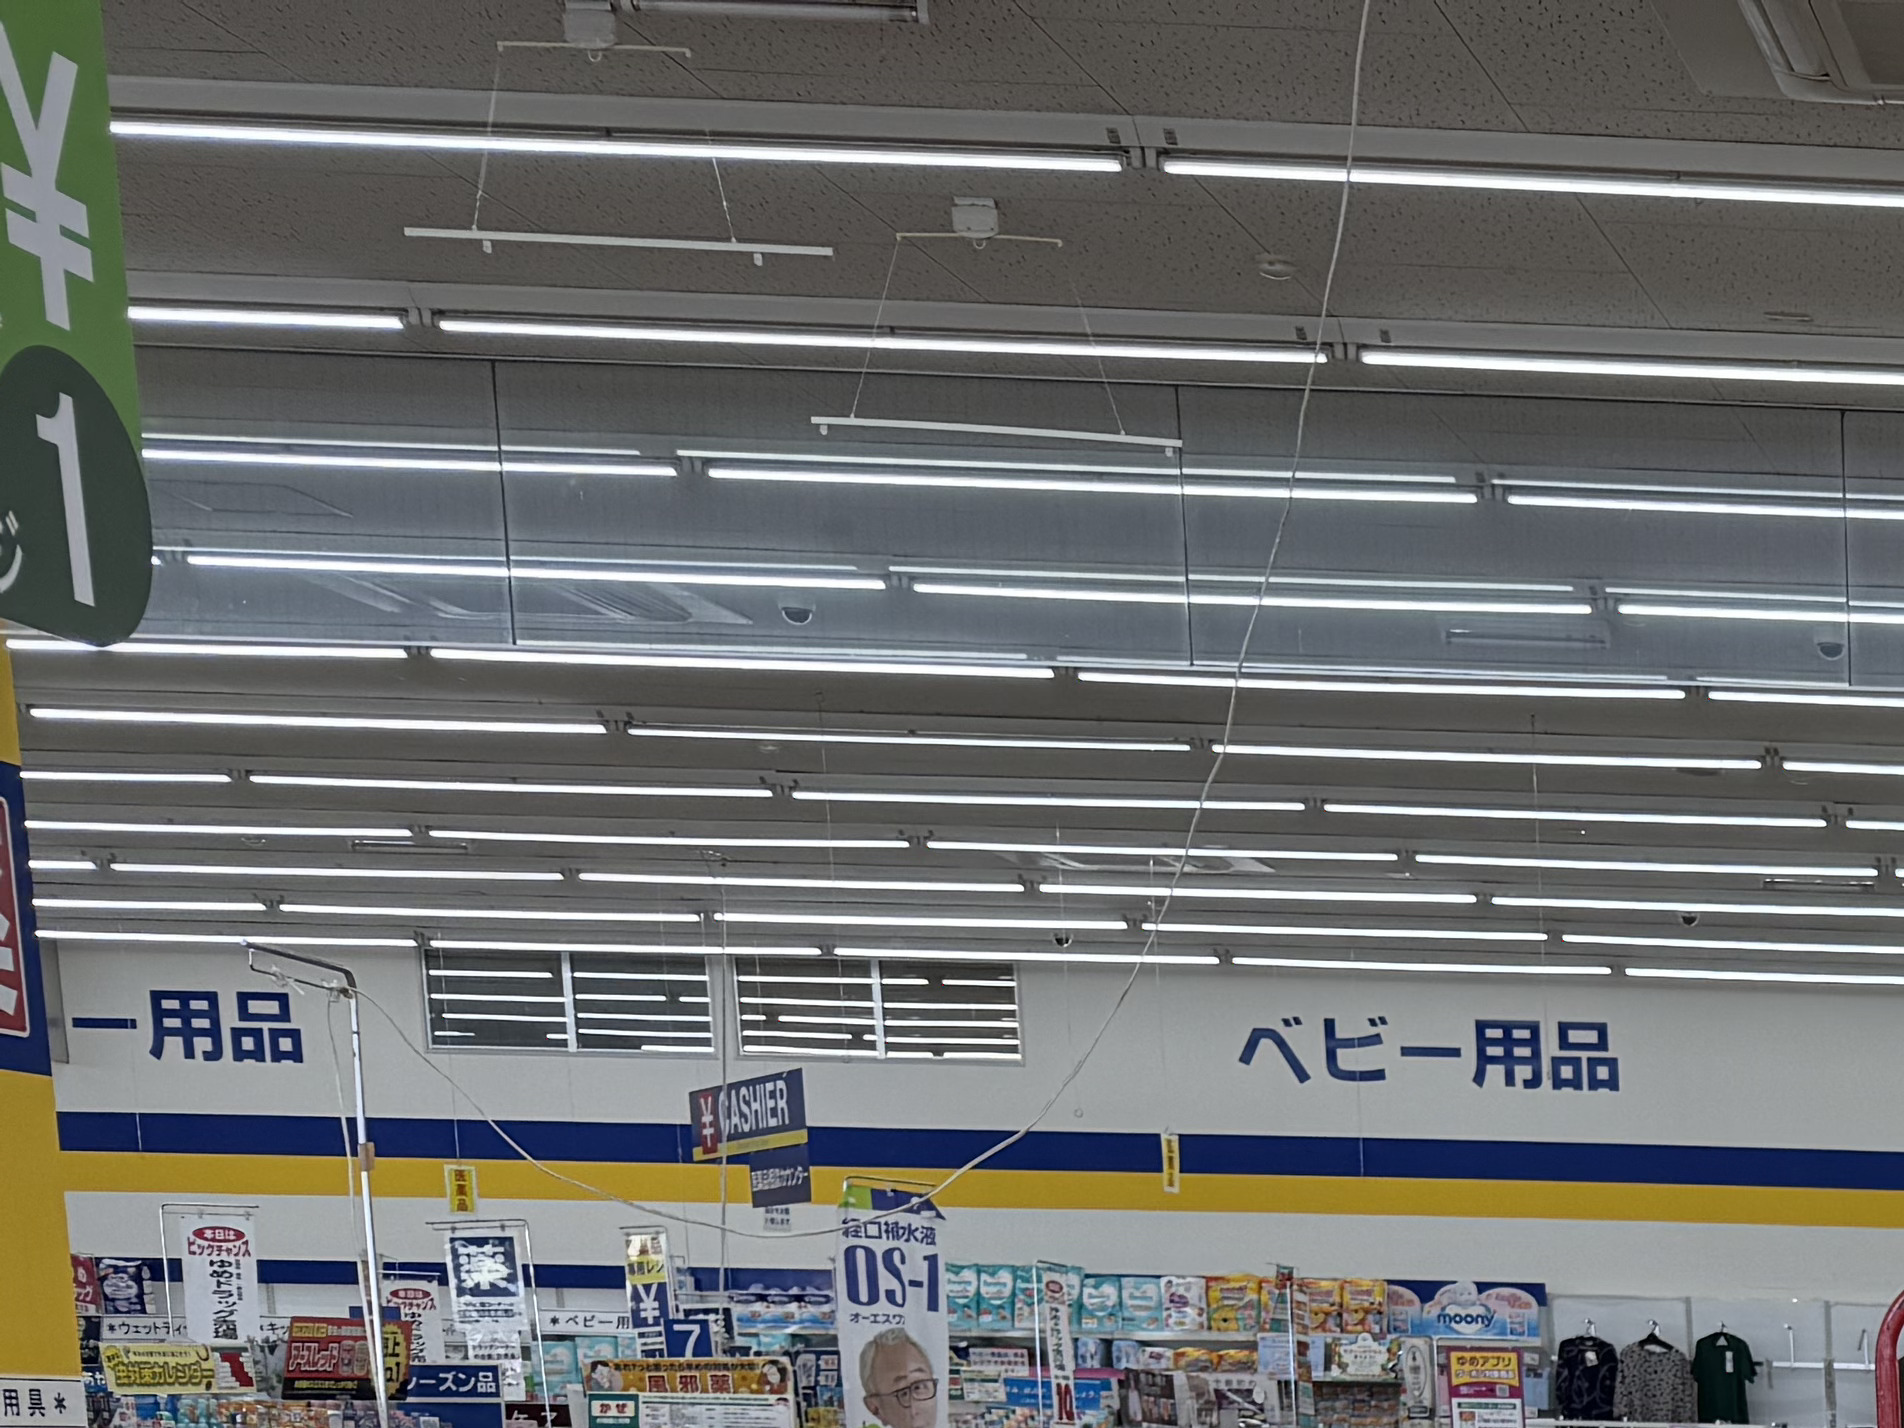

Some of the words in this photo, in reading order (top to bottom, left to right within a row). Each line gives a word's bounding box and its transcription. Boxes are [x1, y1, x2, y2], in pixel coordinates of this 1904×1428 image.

[1238, 1016, 1620, 1092] ベビー用品
[718, 1079, 790, 1138] CASHIER
[842, 1218, 936, 1246] 経口補水液
[457, 1243, 512, 1291] 薬
[844, 1244, 939, 1312] OS-1
[1436, 1308, 1496, 1330] moony
